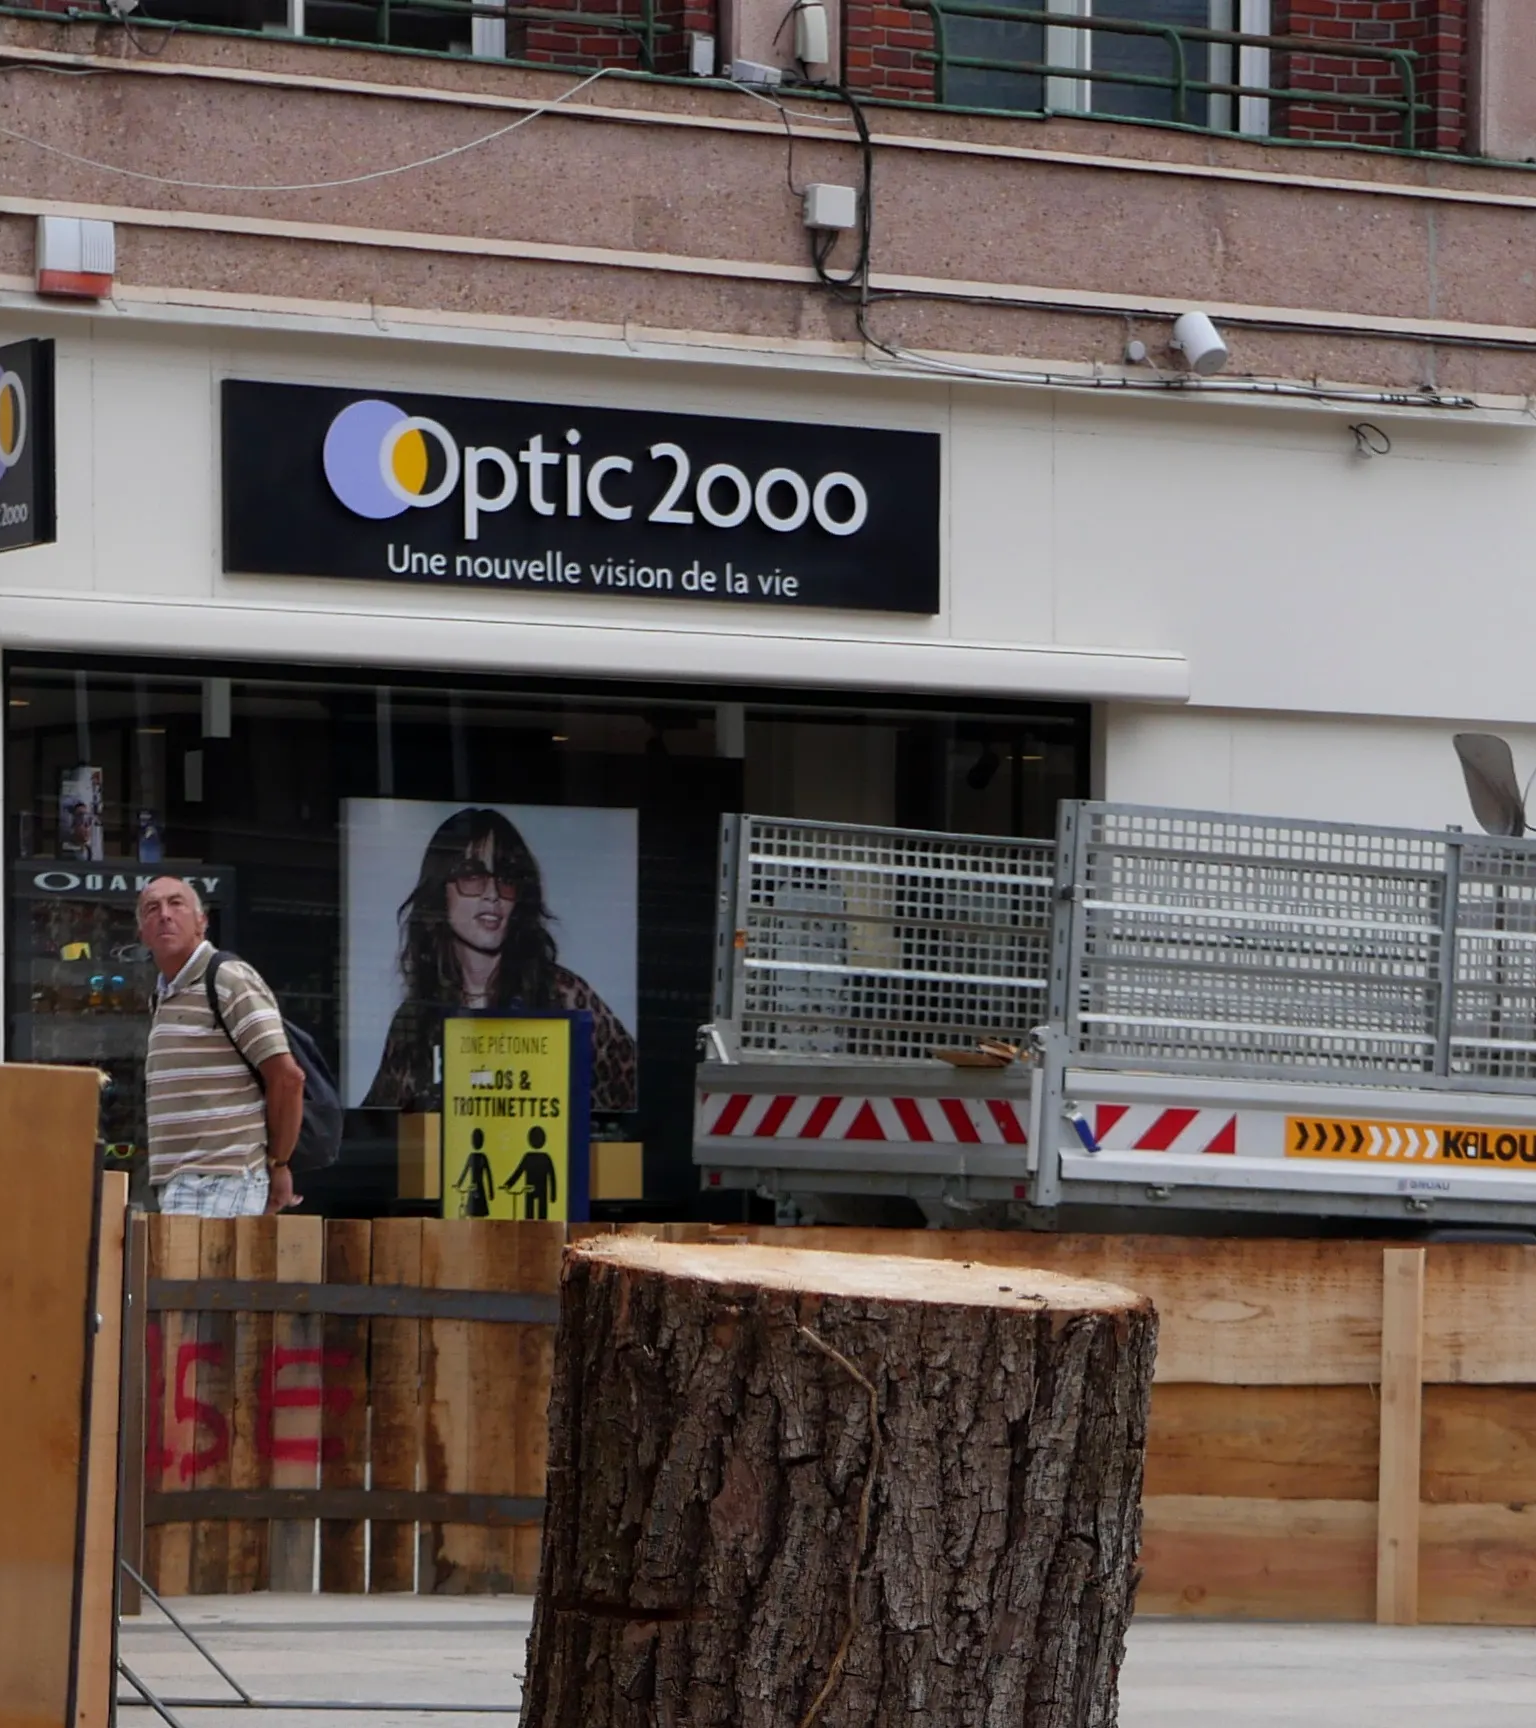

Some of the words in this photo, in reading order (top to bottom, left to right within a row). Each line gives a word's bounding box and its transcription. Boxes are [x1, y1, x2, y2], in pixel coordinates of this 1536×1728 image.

[388, 545, 446, 575] Une
[455, 551, 581, 584] nouvelle
[590, 558, 672, 588] vision
[681, 561, 717, 592] de
[725, 563, 749, 594] la
[758, 569, 798, 596] vie
[85, 874, 220, 892] OAKY
[460, 1036, 484, 1054] ZONE
[488, 1033, 548, 1054] PIÉTONNE
[519, 1070, 531, 1090] &
[454, 1096, 560, 1118] TROTTINETTES
